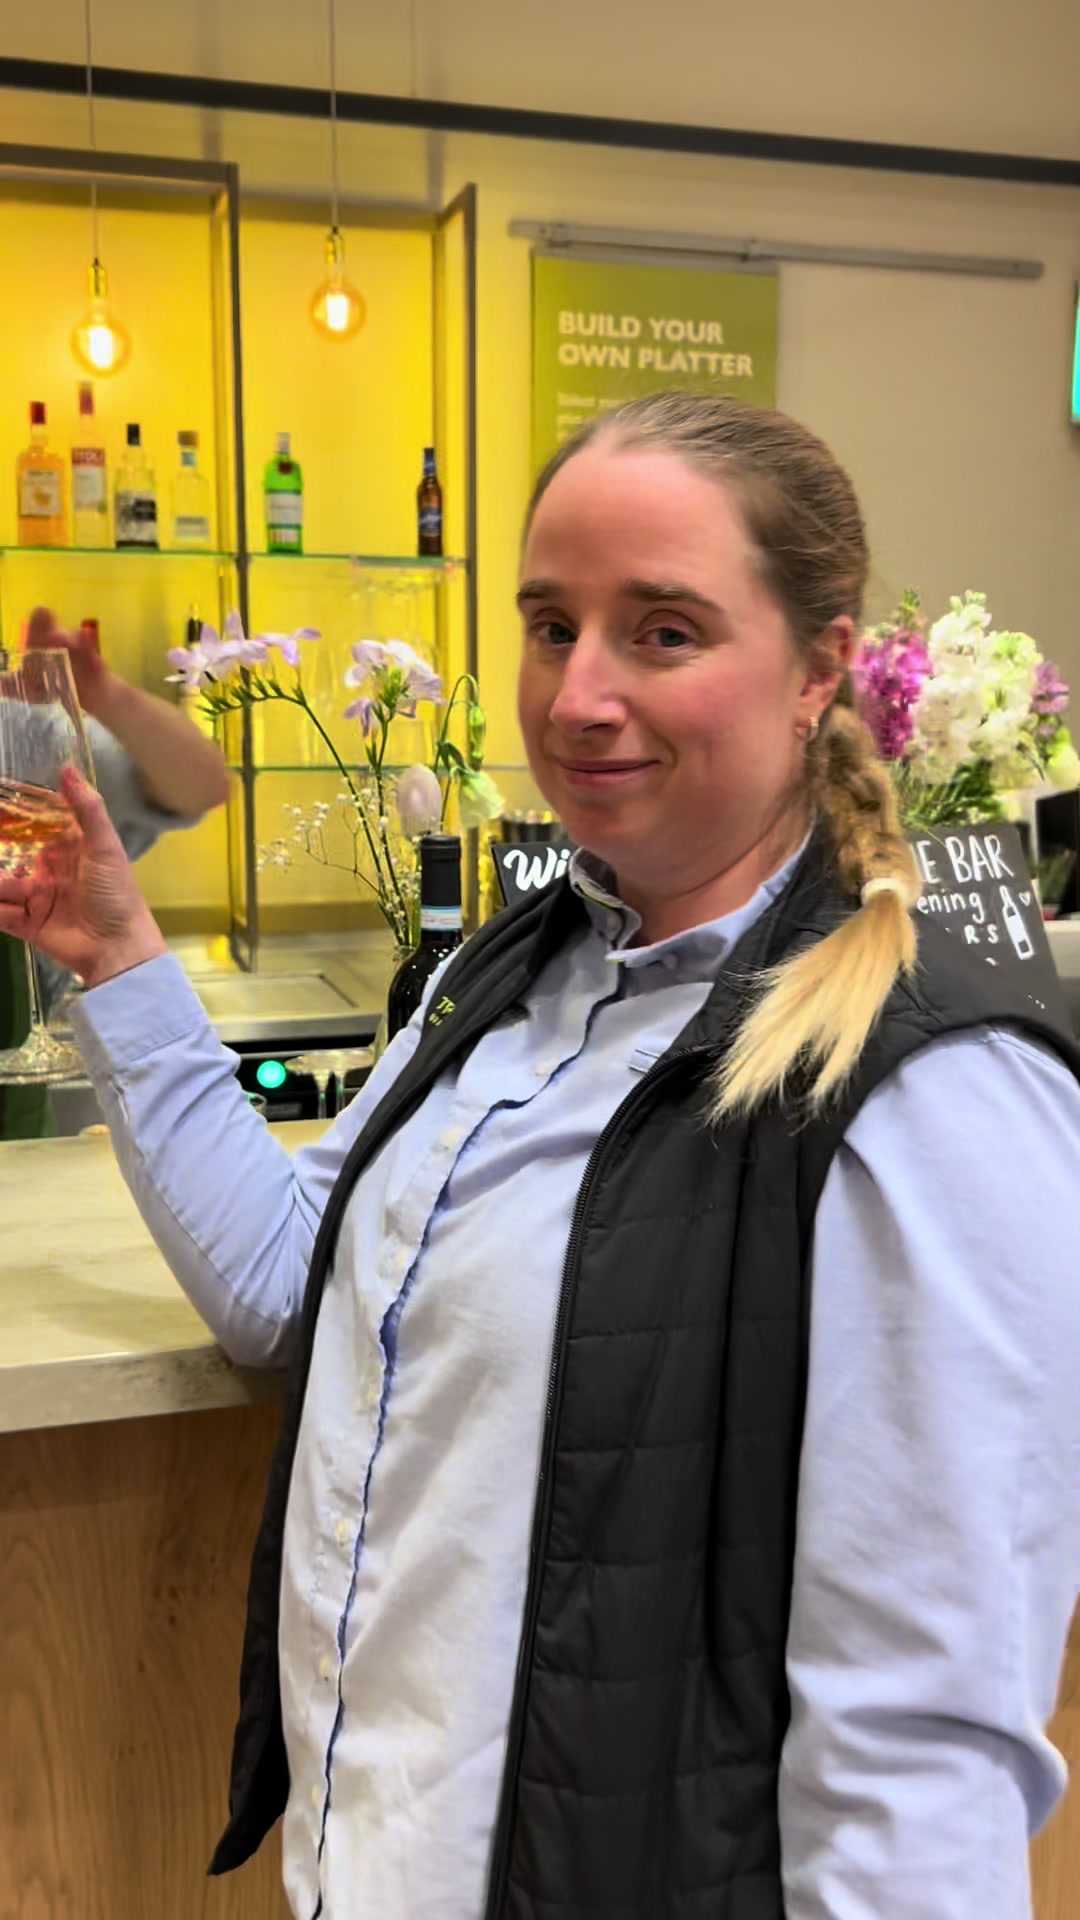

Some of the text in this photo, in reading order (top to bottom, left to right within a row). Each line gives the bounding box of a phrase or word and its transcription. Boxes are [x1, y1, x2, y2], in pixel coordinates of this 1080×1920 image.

[559, 311, 723, 344] BUILD YOUR
[558, 343, 753, 376] OWN PLATTER
[945, 834, 1015, 884] BAR
